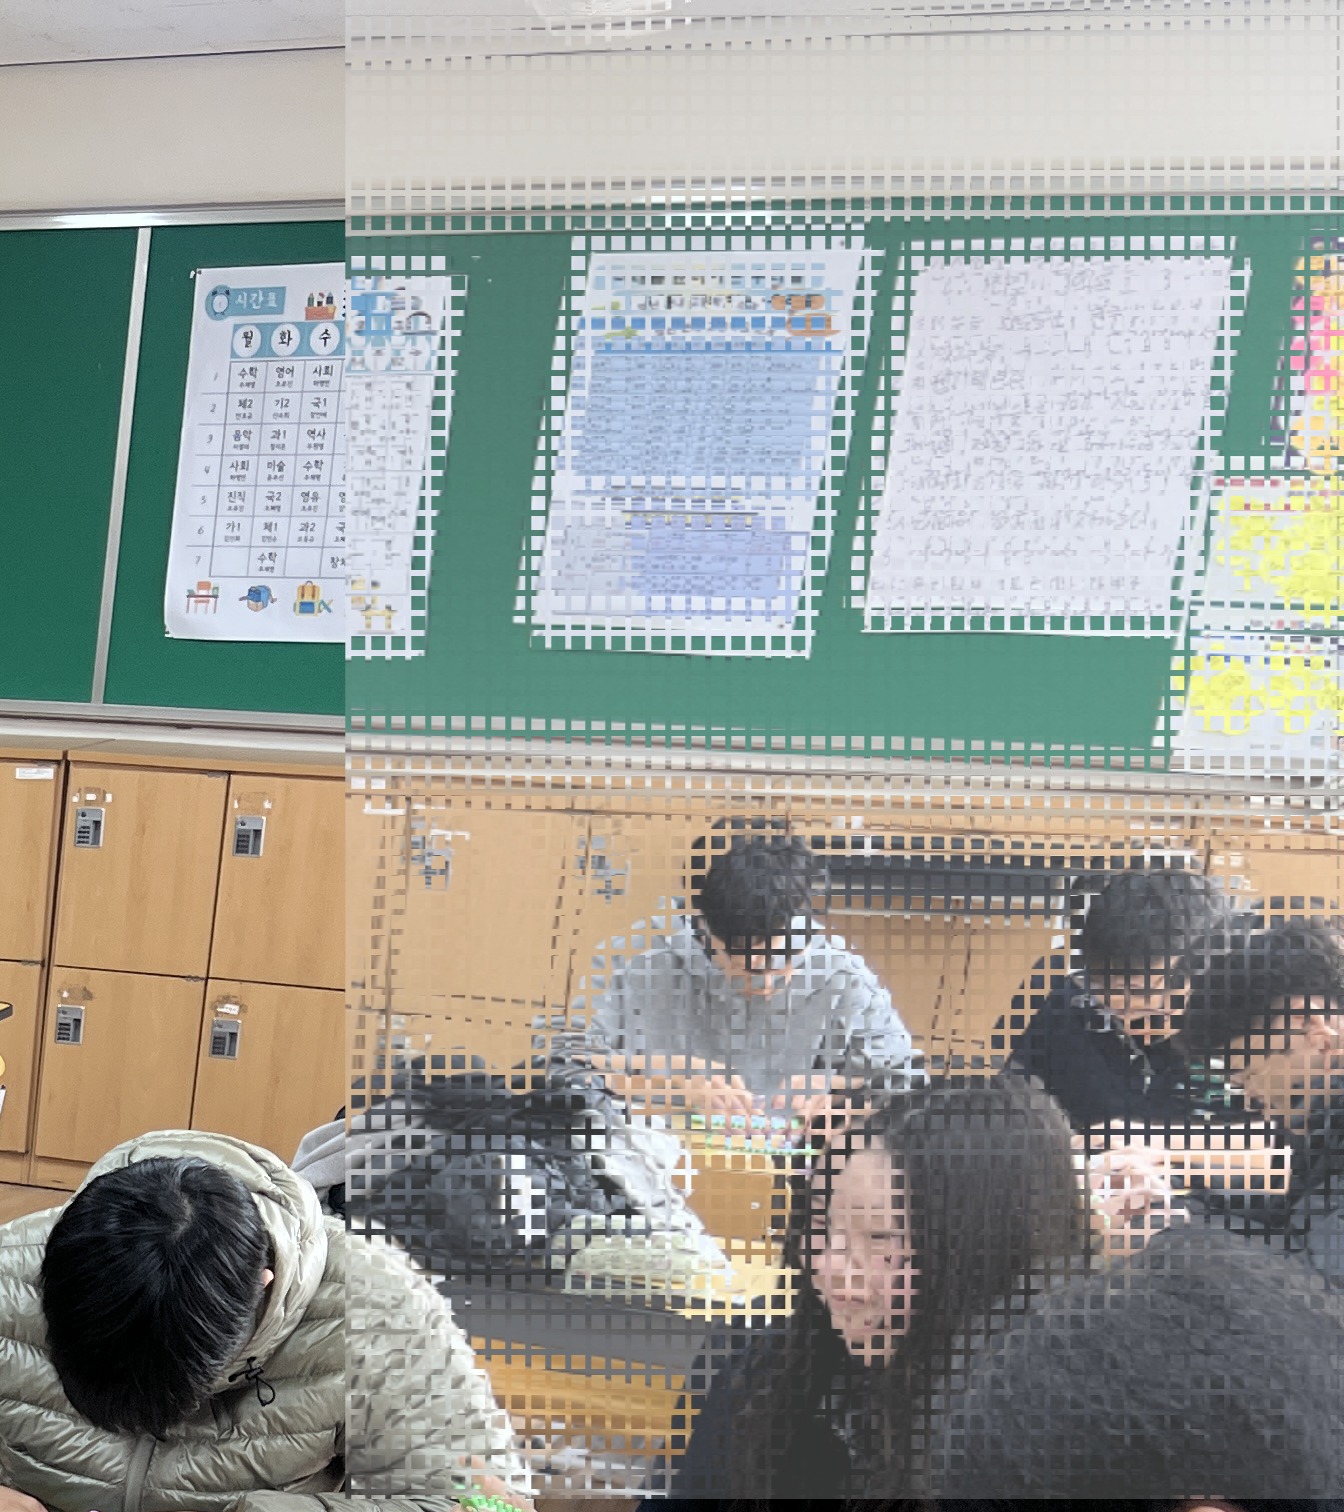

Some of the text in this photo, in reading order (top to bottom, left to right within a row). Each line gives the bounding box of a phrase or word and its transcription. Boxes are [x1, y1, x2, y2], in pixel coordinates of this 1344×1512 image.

[235, 290, 279, 309] 시간표
[242, 329, 331, 348] 월 화 수
[238, 366, 258, 379] 수학
[276, 366, 295, 379] 영어
[312, 365, 333, 377] 사회
[275, 399, 290, 410] 기2
[232, 430, 252, 442] 음악
[307, 429, 326, 441] 역사
[229, 460, 250, 472] 사회
[267, 460, 286, 472] 미술
[303, 459, 324, 471] 수학
[265, 491, 282, 503] 국2
[226, 521, 241, 533] 가1
[299, 522, 316, 533] 과2
[257, 552, 277, 563] 수학
